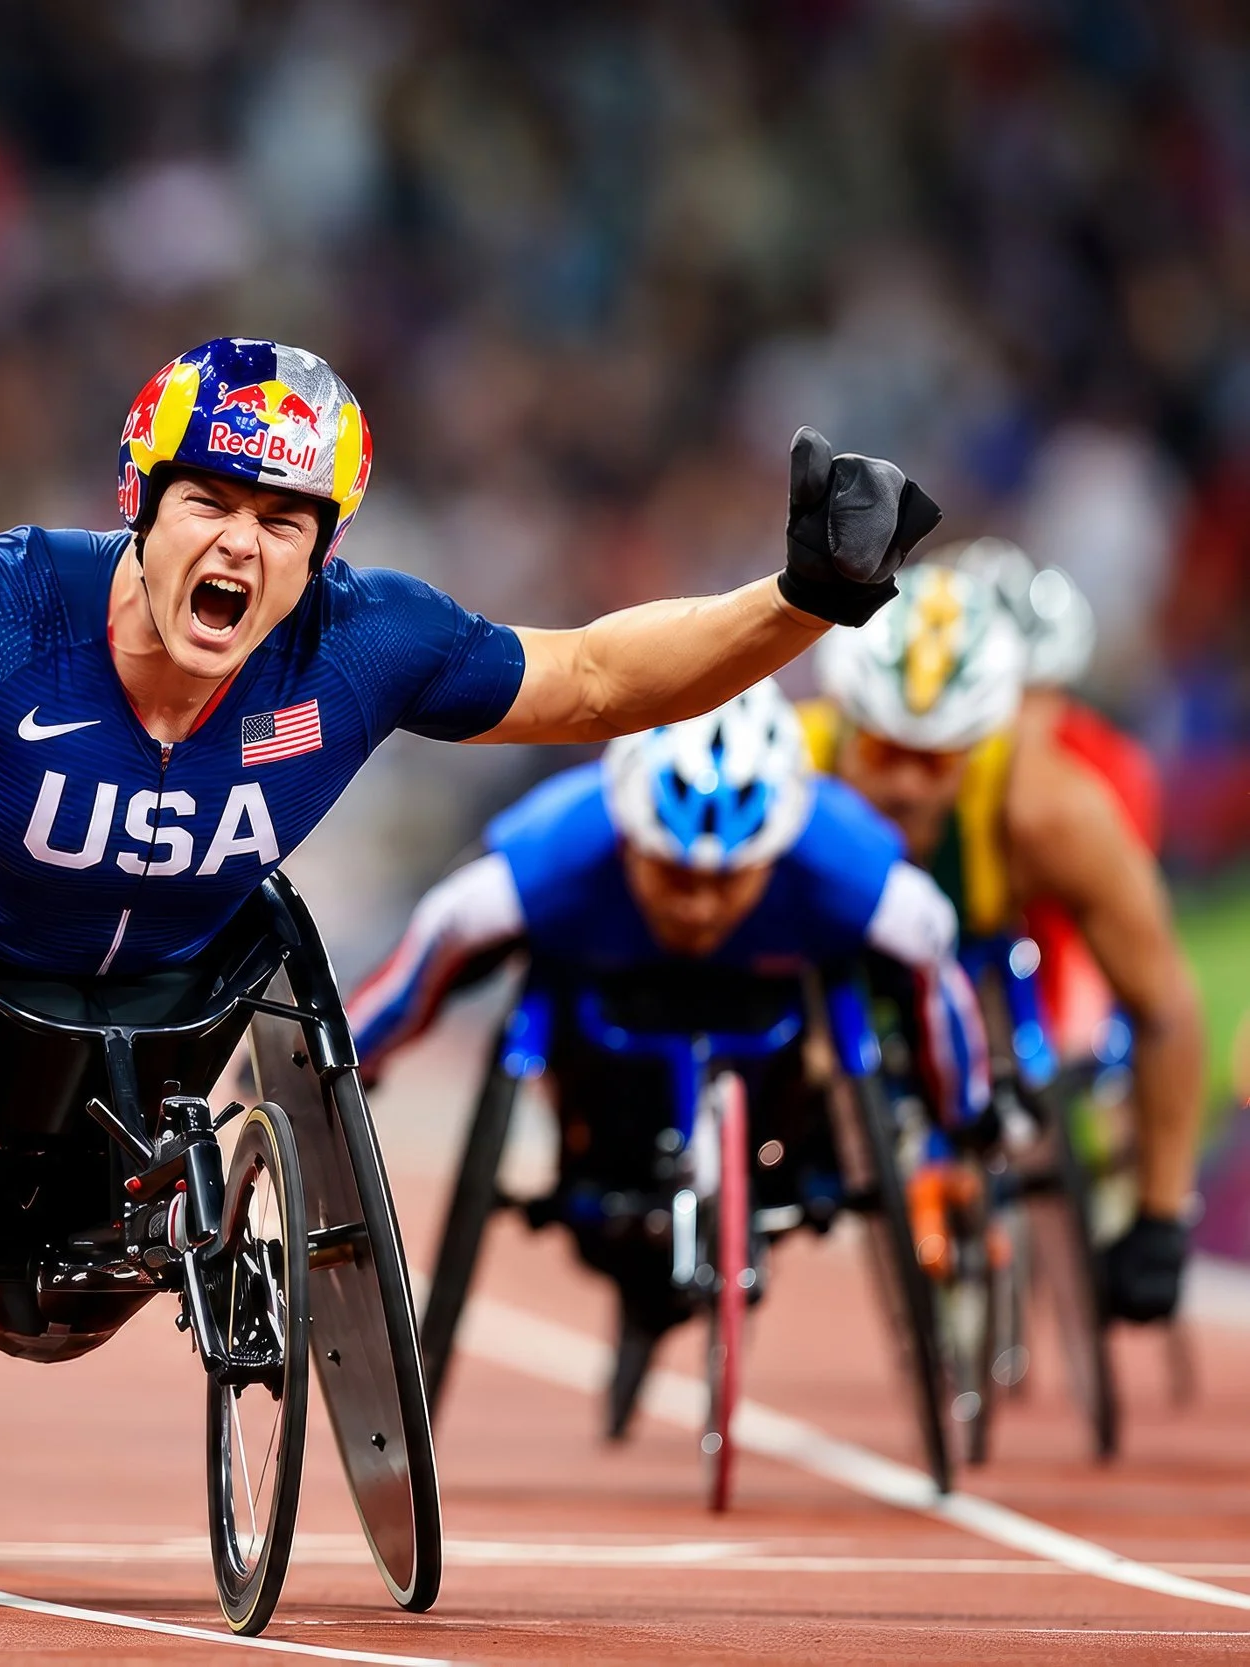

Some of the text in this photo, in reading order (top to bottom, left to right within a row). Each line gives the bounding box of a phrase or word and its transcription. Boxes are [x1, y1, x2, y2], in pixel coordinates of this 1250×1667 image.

[210, 423, 317, 471] Red Bull
[23, 770, 280, 876] USA
